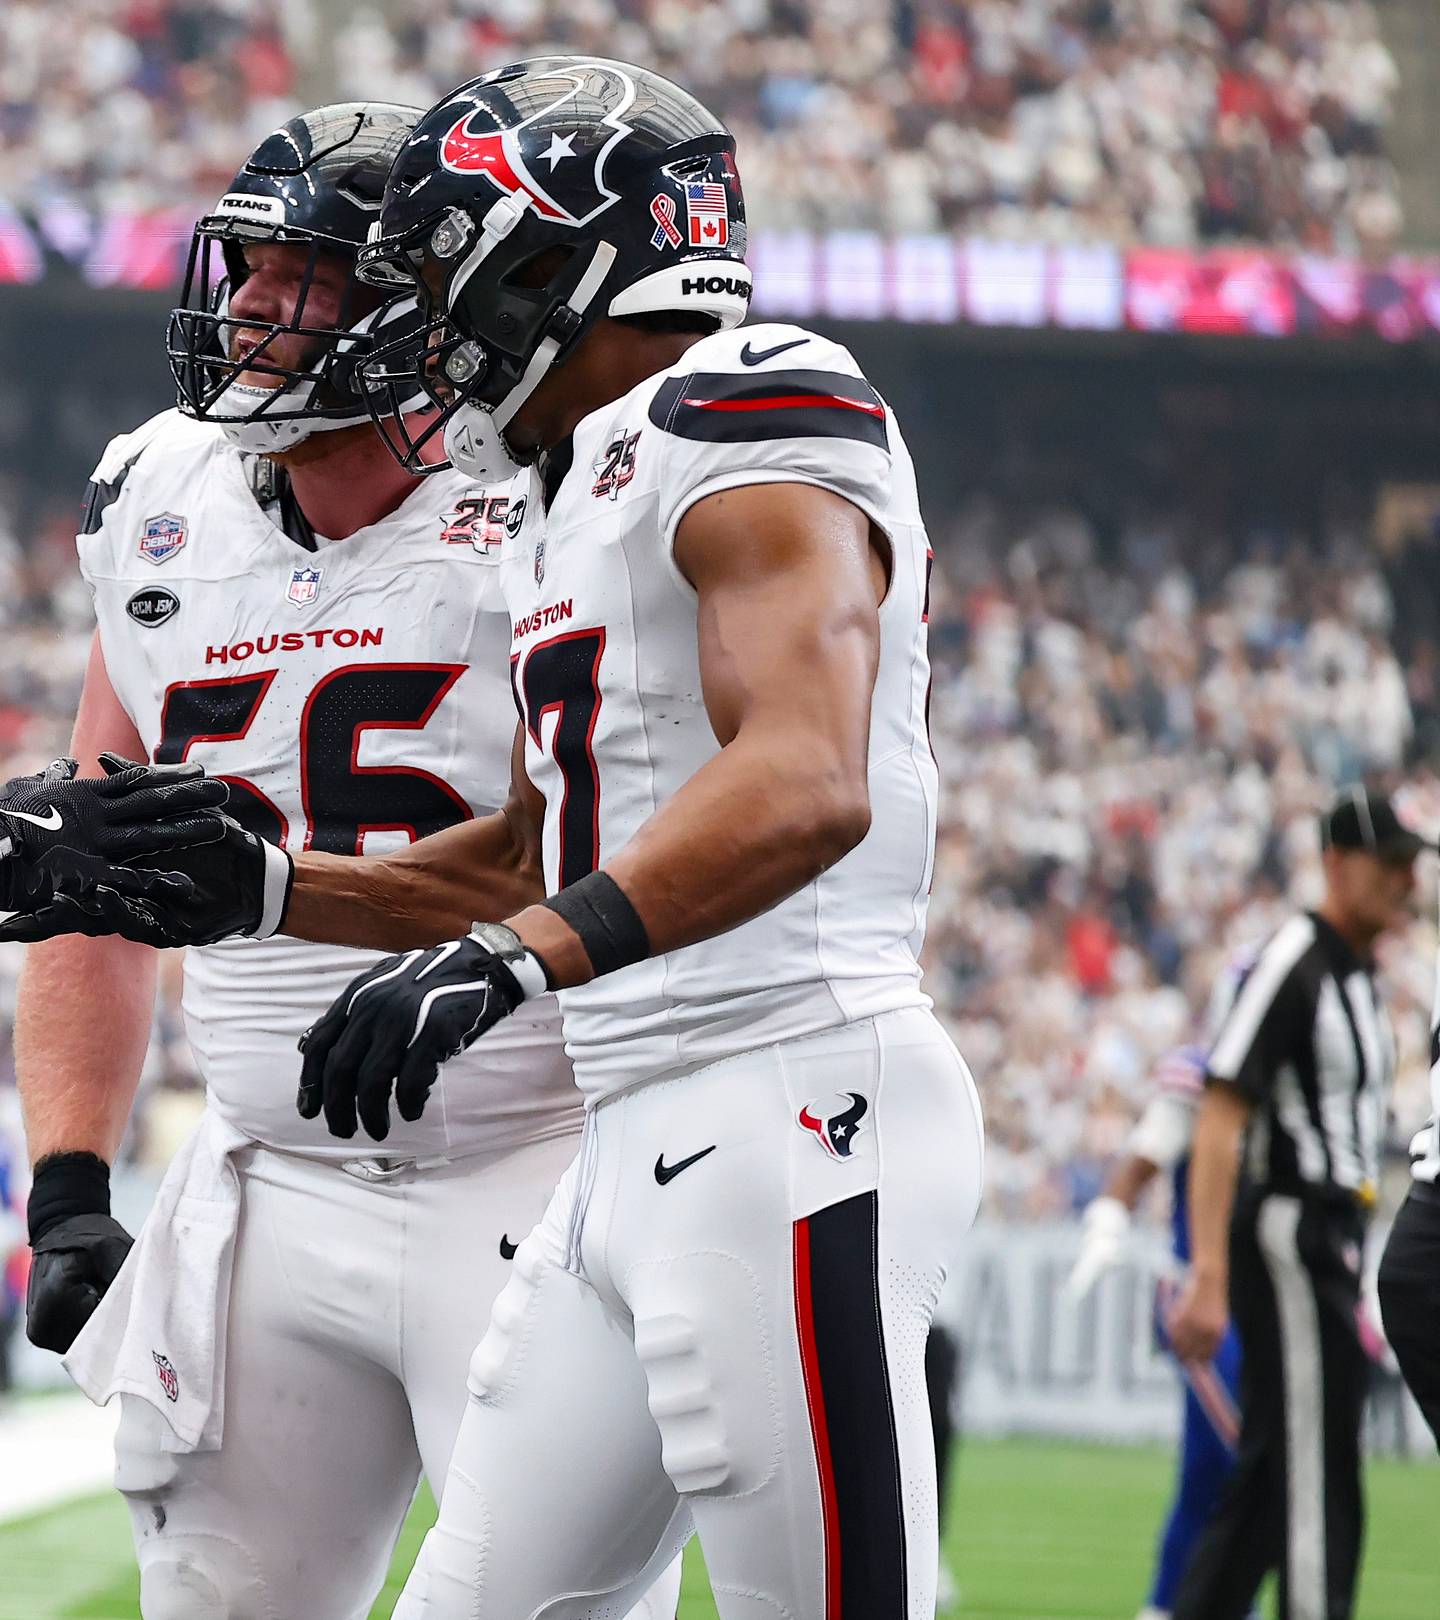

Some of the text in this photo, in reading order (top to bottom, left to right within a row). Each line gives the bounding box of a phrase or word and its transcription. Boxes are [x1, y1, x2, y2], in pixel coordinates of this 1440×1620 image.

[222, 199, 272, 212] TEXANS
[681, 277, 751, 299] HOUS
[142, 534, 178, 547] DEBUT
[131, 599, 174, 615] RCM JSM
[513, 598, 573, 640] HOUSTON
[205, 627, 384, 665] HOUSTON
[153, 662, 474, 858] 56
[509, 625, 607, 891] 7
